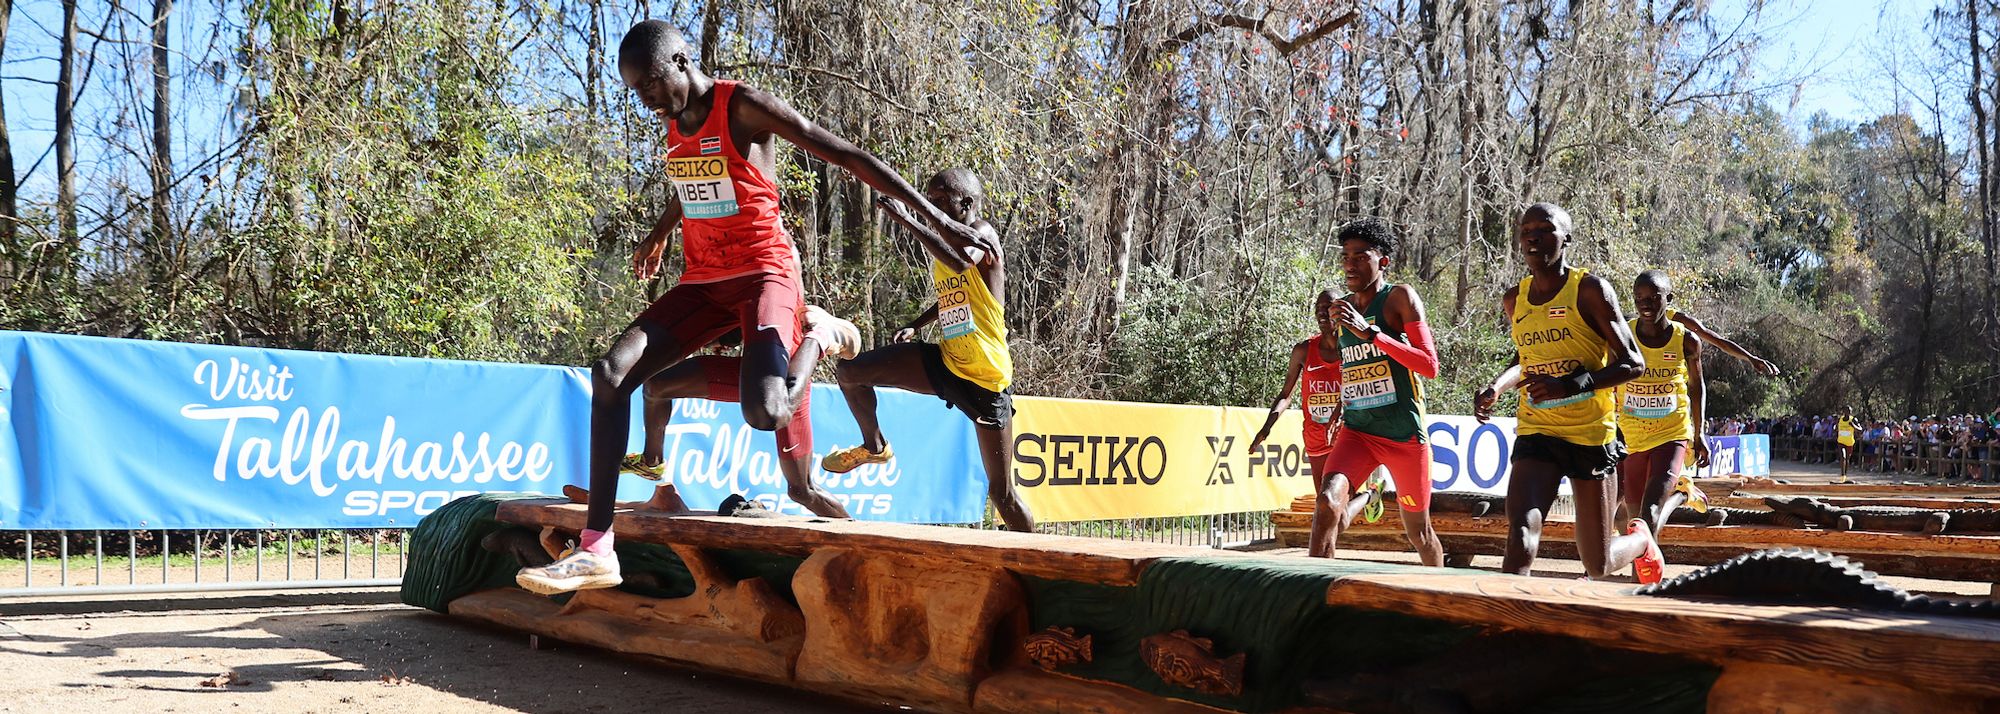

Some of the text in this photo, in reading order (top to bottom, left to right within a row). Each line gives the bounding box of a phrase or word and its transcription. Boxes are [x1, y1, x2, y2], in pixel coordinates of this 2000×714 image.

[667, 159, 723, 178] SEIKO
[681, 182, 721, 201] IBET
[1516, 327, 1574, 347] UGANDA
[193, 356, 294, 402] Visit
[1342, 364, 1388, 384] SEIKO
[1643, 367, 1677, 378] ANDA
[1309, 380, 1342, 393] KENY
[1343, 379, 1389, 399] SEWNET
[1625, 382, 1674, 395] SEIKO
[1311, 406, 1336, 416] KIPT
[1626, 395, 1673, 408] ANDIEMA
[181, 403, 552, 496] Tallahassee
[1427, 421, 1510, 490] SO
[1013, 432, 1167, 488] SEIKO
[1248, 443, 1313, 478] PROS
